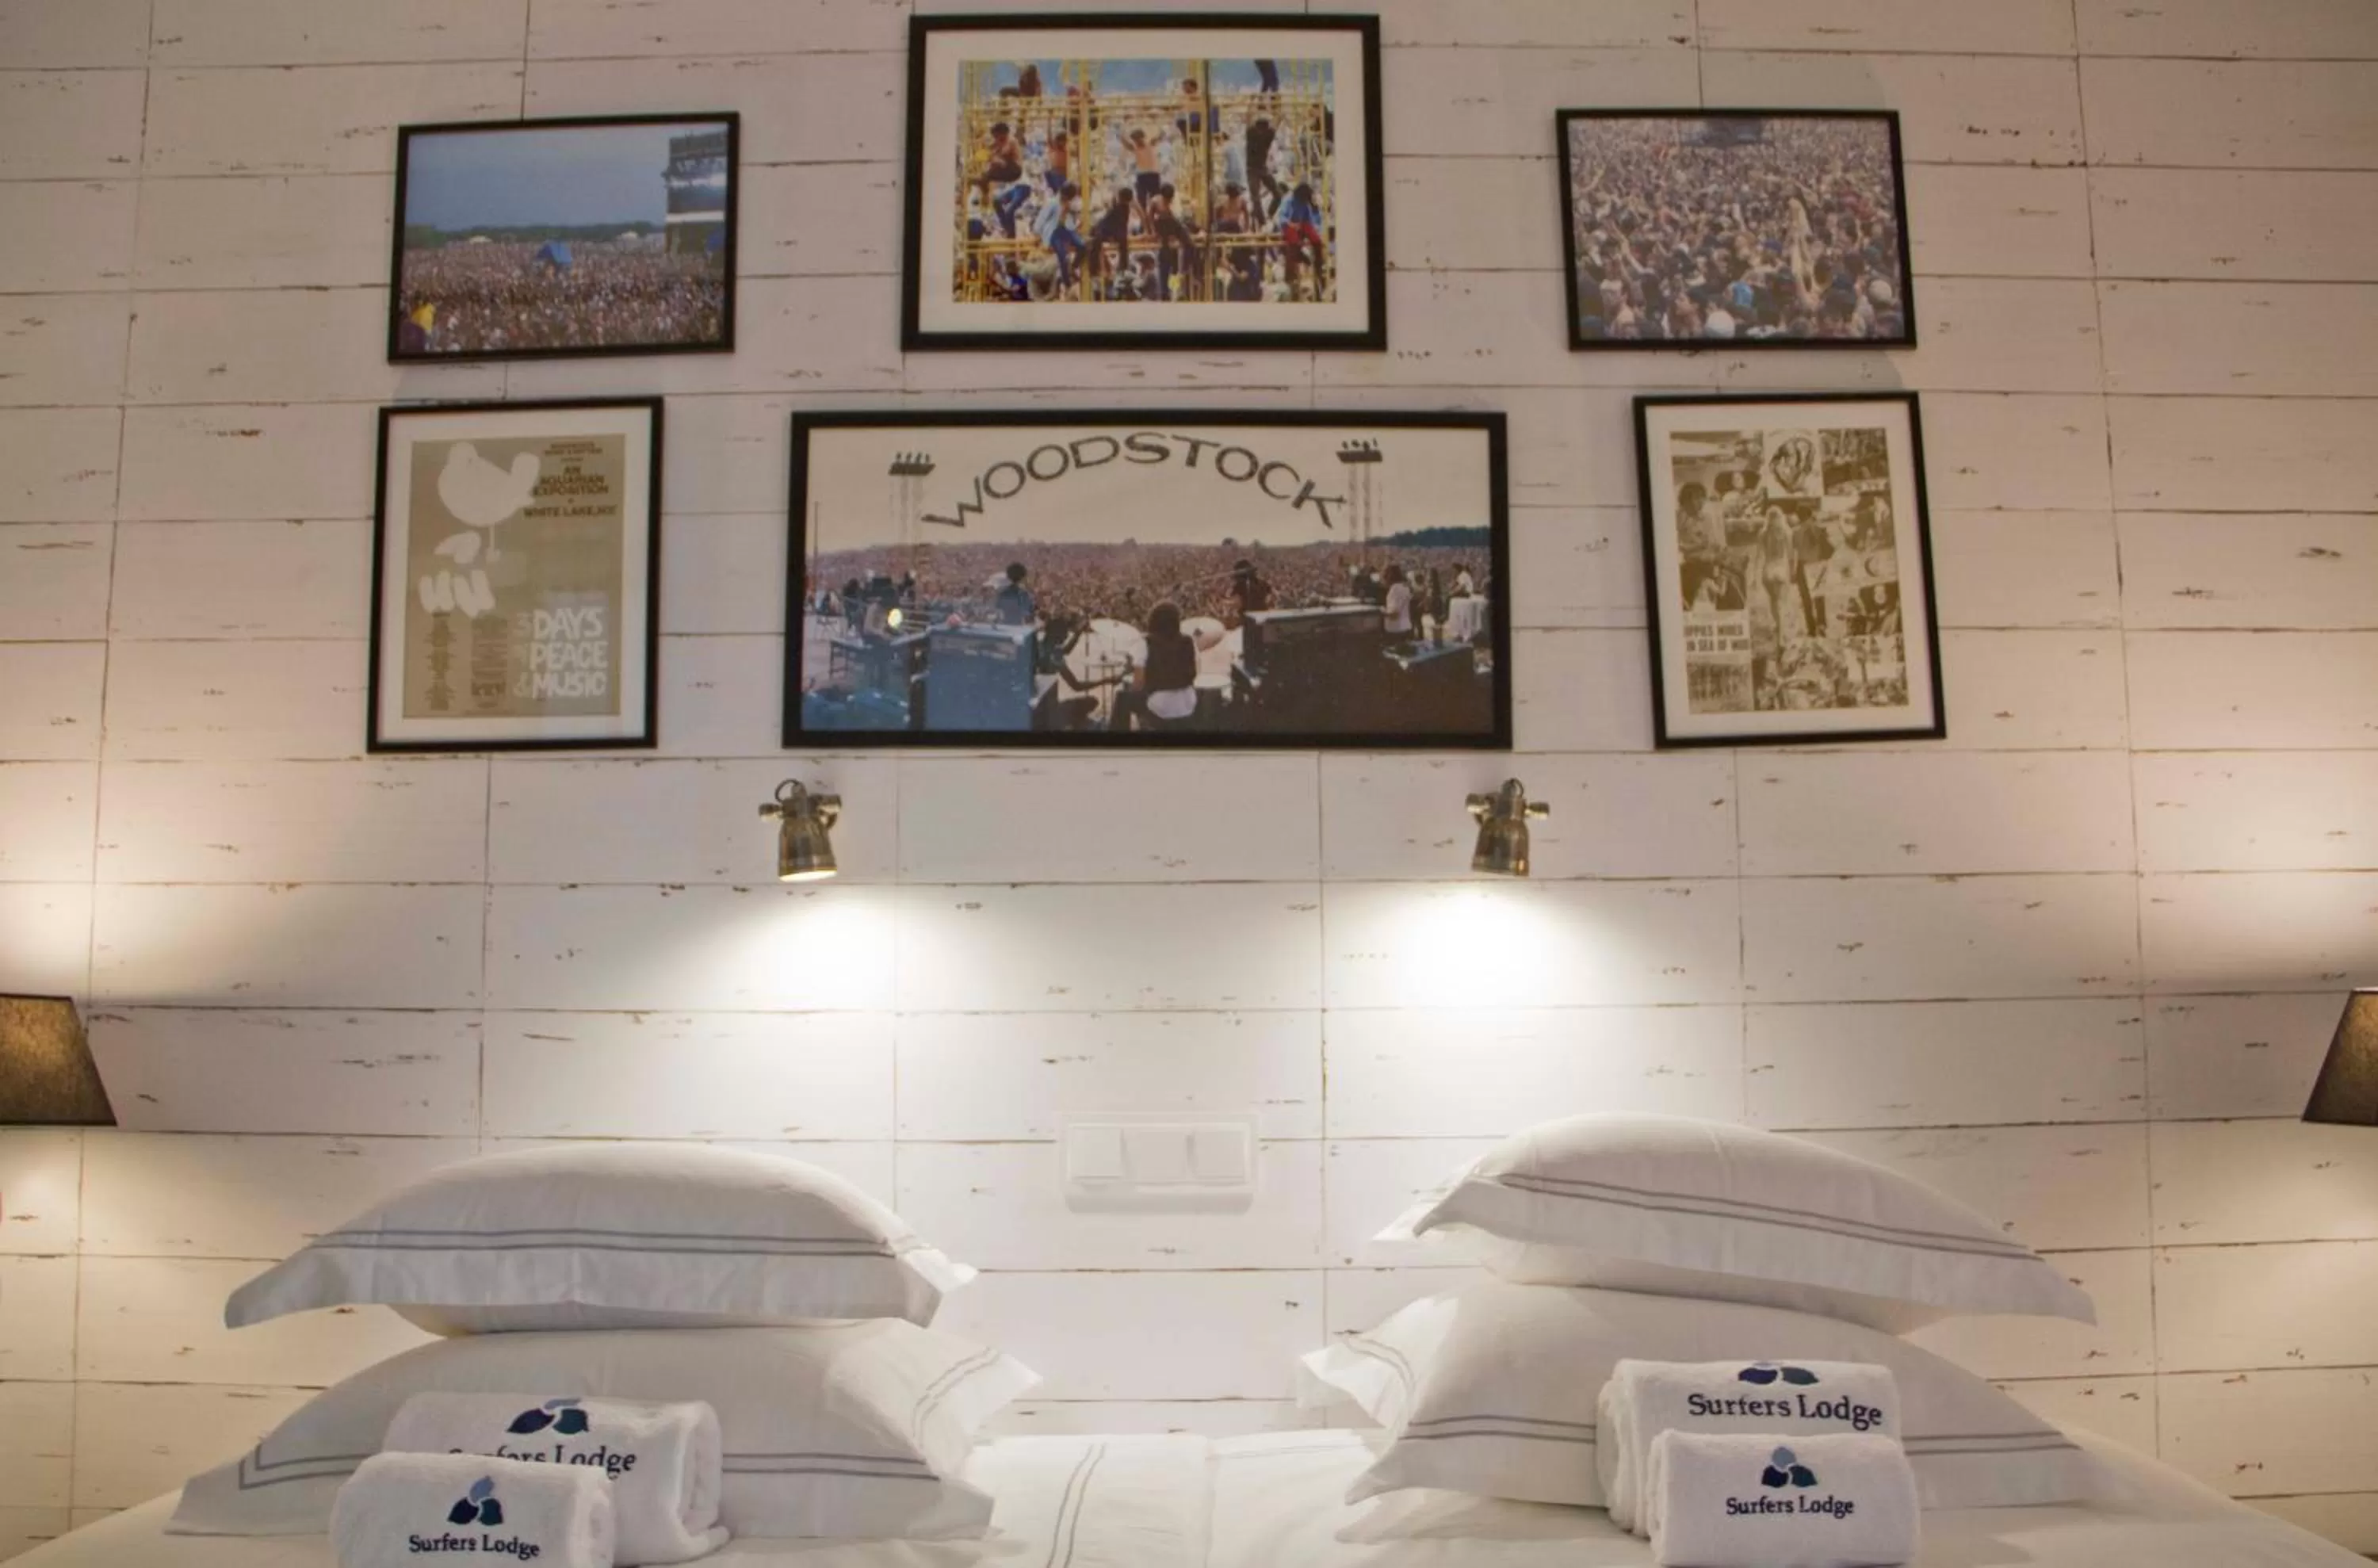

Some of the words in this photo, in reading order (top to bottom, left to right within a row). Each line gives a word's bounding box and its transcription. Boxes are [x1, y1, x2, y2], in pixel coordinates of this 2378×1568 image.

[921, 432, 1347, 529] WOODSTOCK
[532, 606, 604, 640] DAYS
[530, 640, 609, 671] PEACE
[532, 670, 607, 699] MUSIC
[1687, 1393, 1791, 1417] Surfers
[1796, 1394, 1883, 1432] Lodge
[1725, 1494, 1795, 1516] Surfers
[1798, 1493, 1855, 1520] Lodge
[408, 1532, 477, 1553] Surfers
[481, 1533, 541, 1561] Lodge
